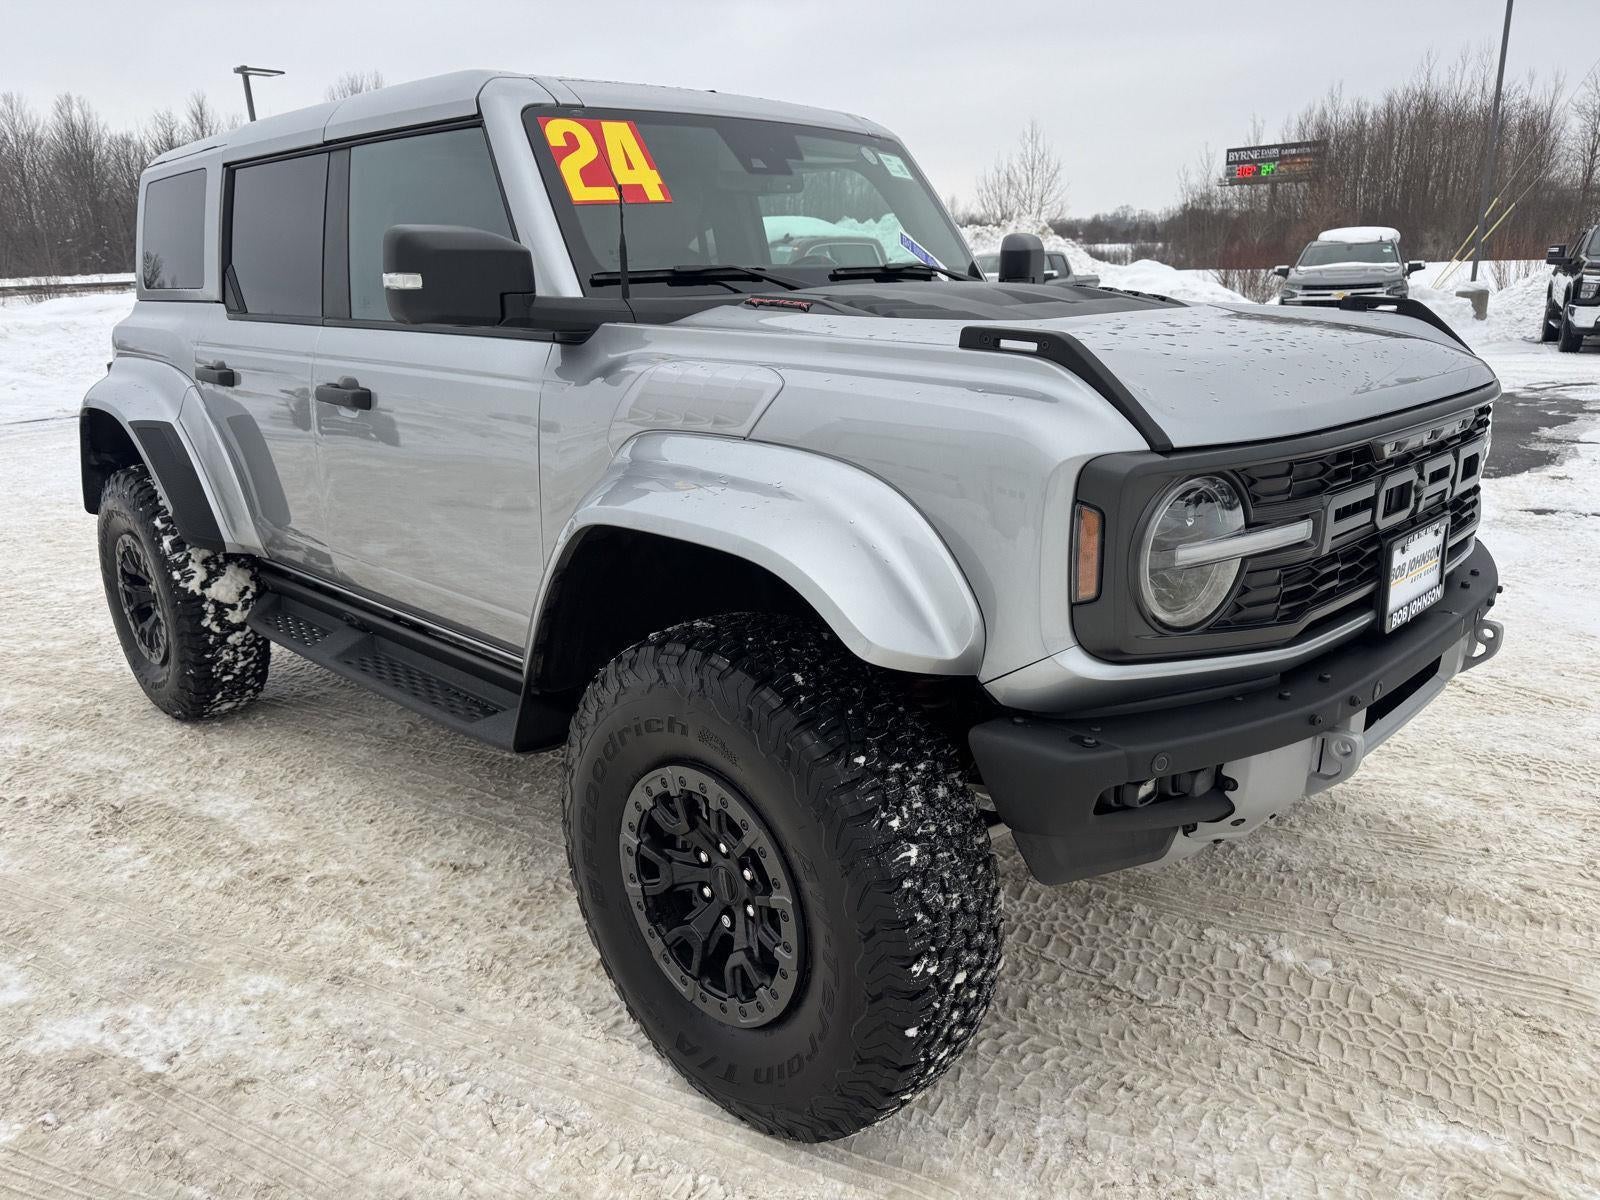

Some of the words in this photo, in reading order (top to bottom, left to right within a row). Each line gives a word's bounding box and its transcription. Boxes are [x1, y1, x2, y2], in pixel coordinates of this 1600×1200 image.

[545, 118, 665, 201] 24
[1228, 149, 1260, 161] BYRNE
[1321, 436, 1487, 556] FORD
[1406, 544, 1442, 579] JOHNSON
[1391, 604, 1409, 628] BOB
[1408, 584, 1442, 622] JOHNSON
